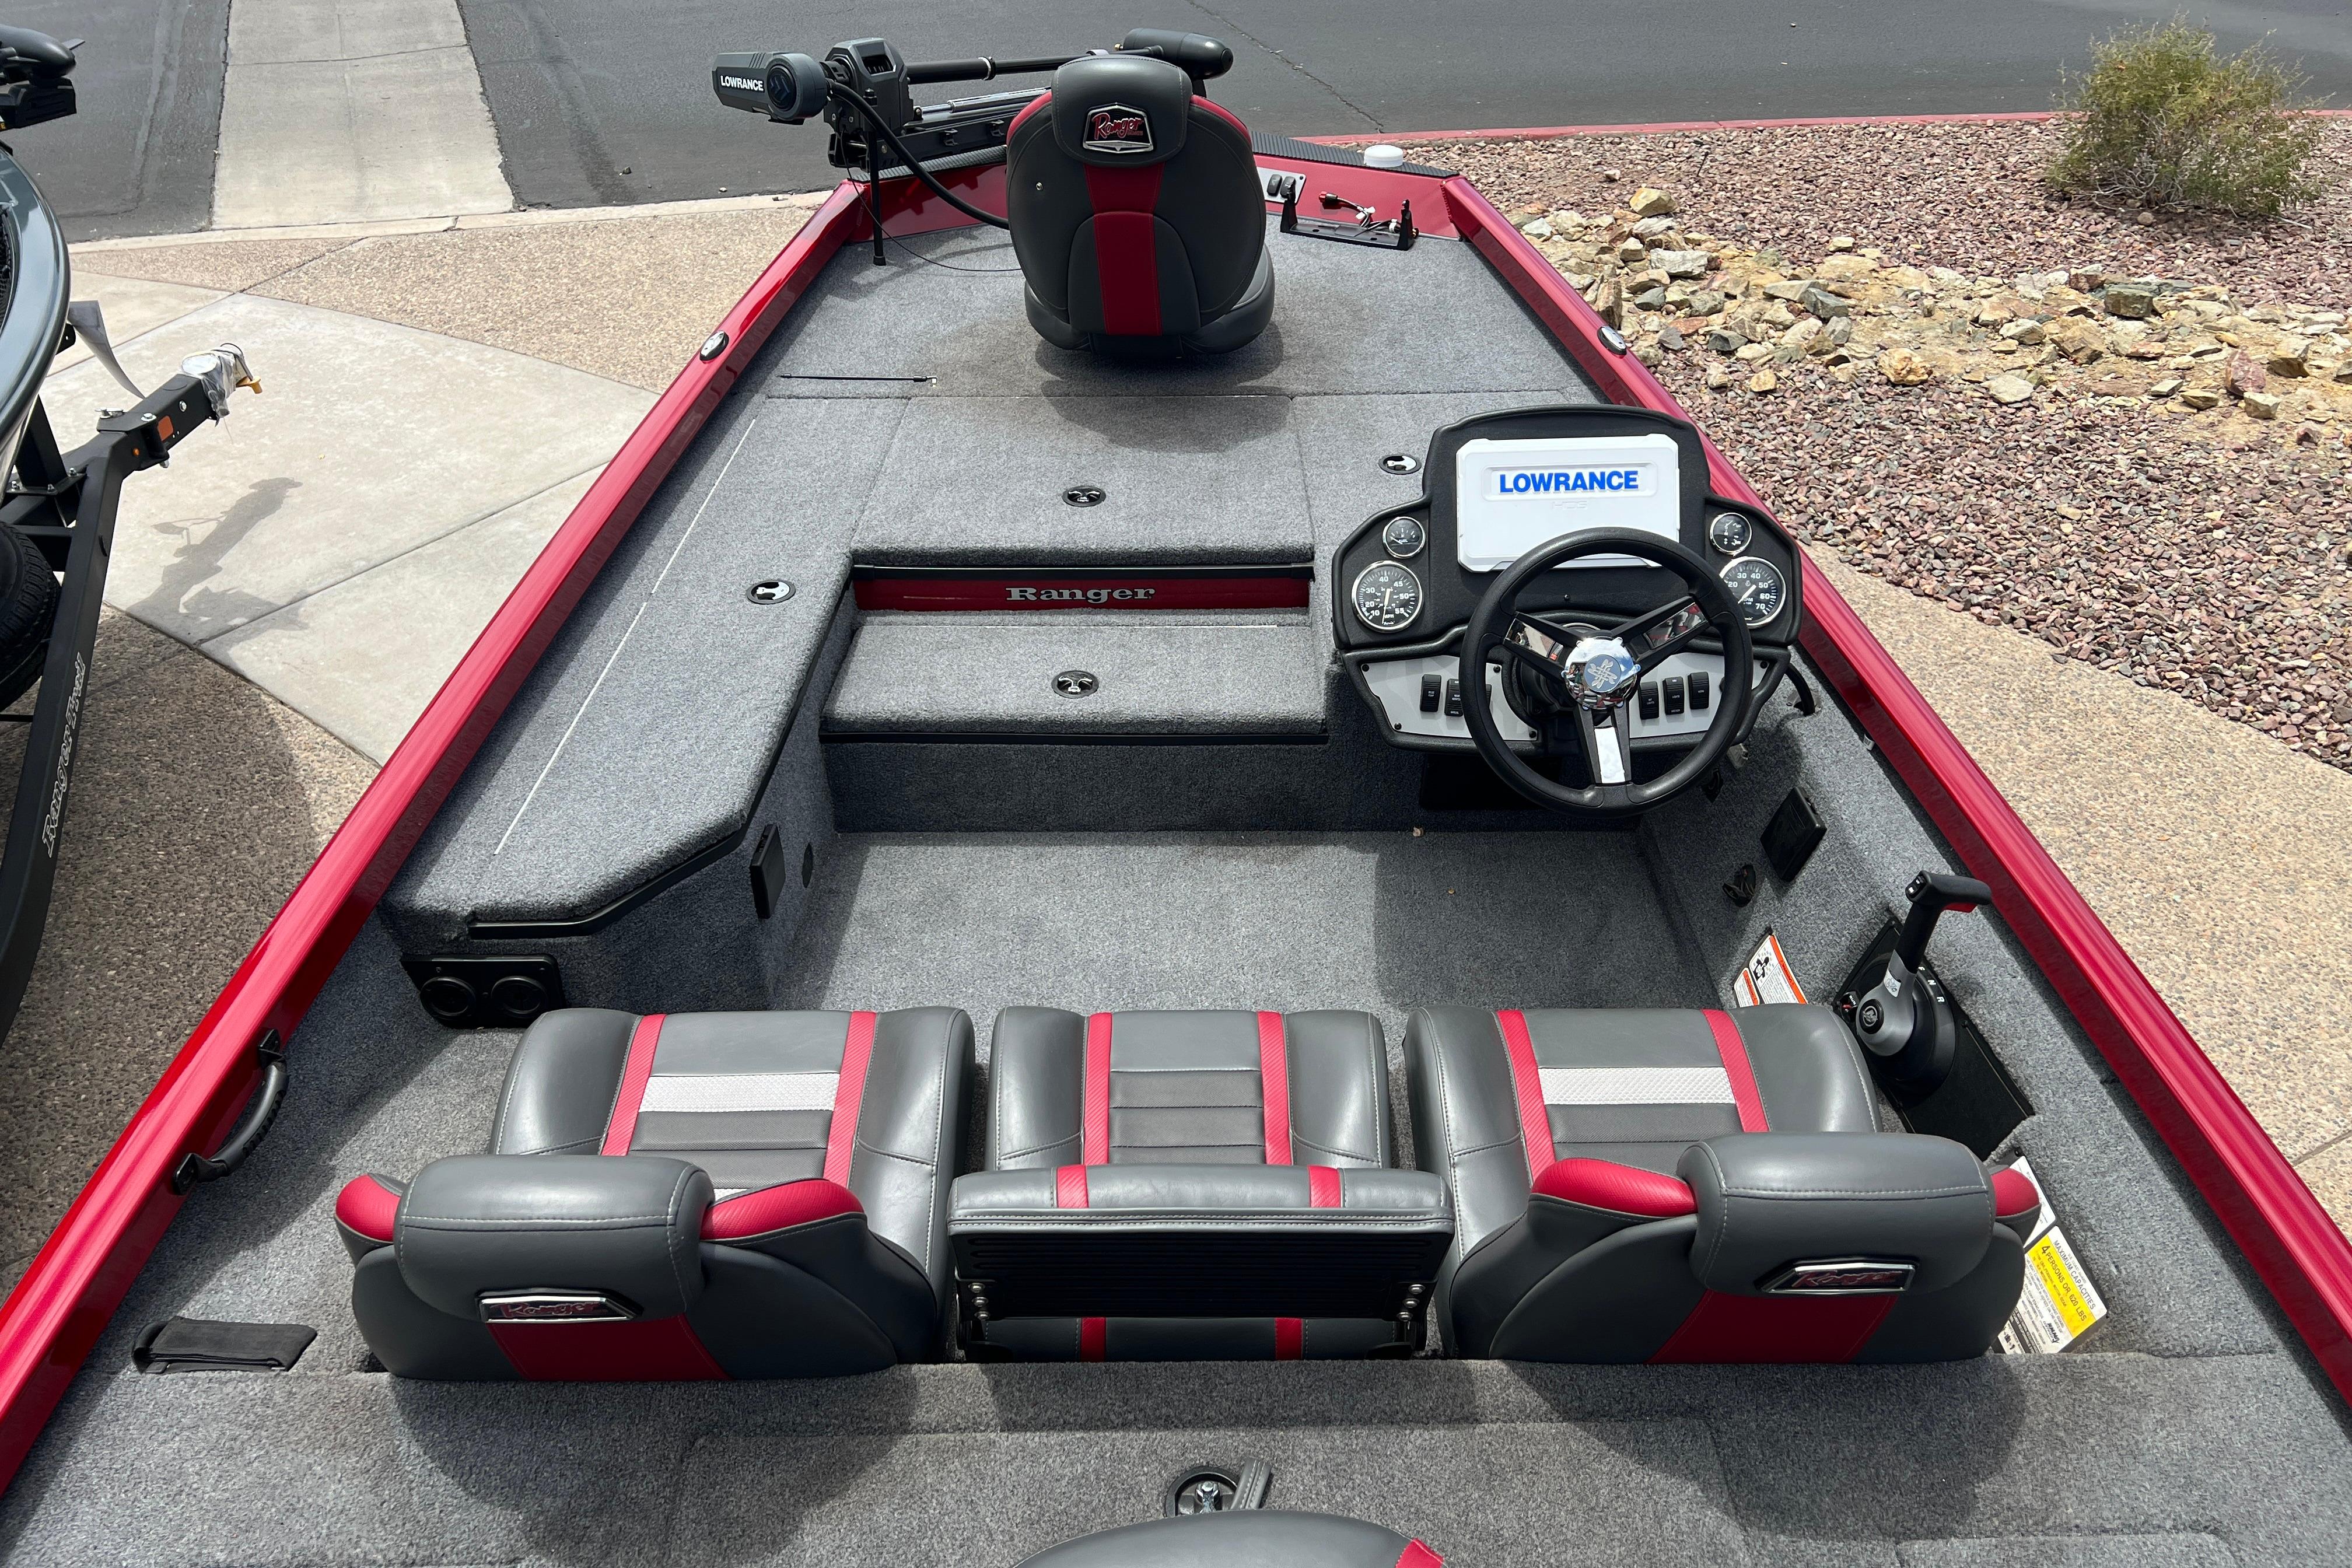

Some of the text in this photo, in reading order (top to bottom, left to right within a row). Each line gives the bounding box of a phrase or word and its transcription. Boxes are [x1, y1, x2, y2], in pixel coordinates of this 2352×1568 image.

[720, 75, 764, 91] LOWRANCE
[1091, 113, 1144, 140] Ranger
[1500, 471, 1639, 494] LOWRANCE
[1006, 587, 1155, 604] Ranger
[42, 724, 72, 858] Ranger
[2039, 1242, 2051, 1255] 4
[2045, 1251, 2065, 1283] PERSONS
[2062, 1282, 2071, 1294] OR
[2068, 1293, 2078, 1307] 620
[2076, 1306, 2087, 1321] LBS
[2053, 1239, 2096, 1310] MAXIMUM CAPACITIES
